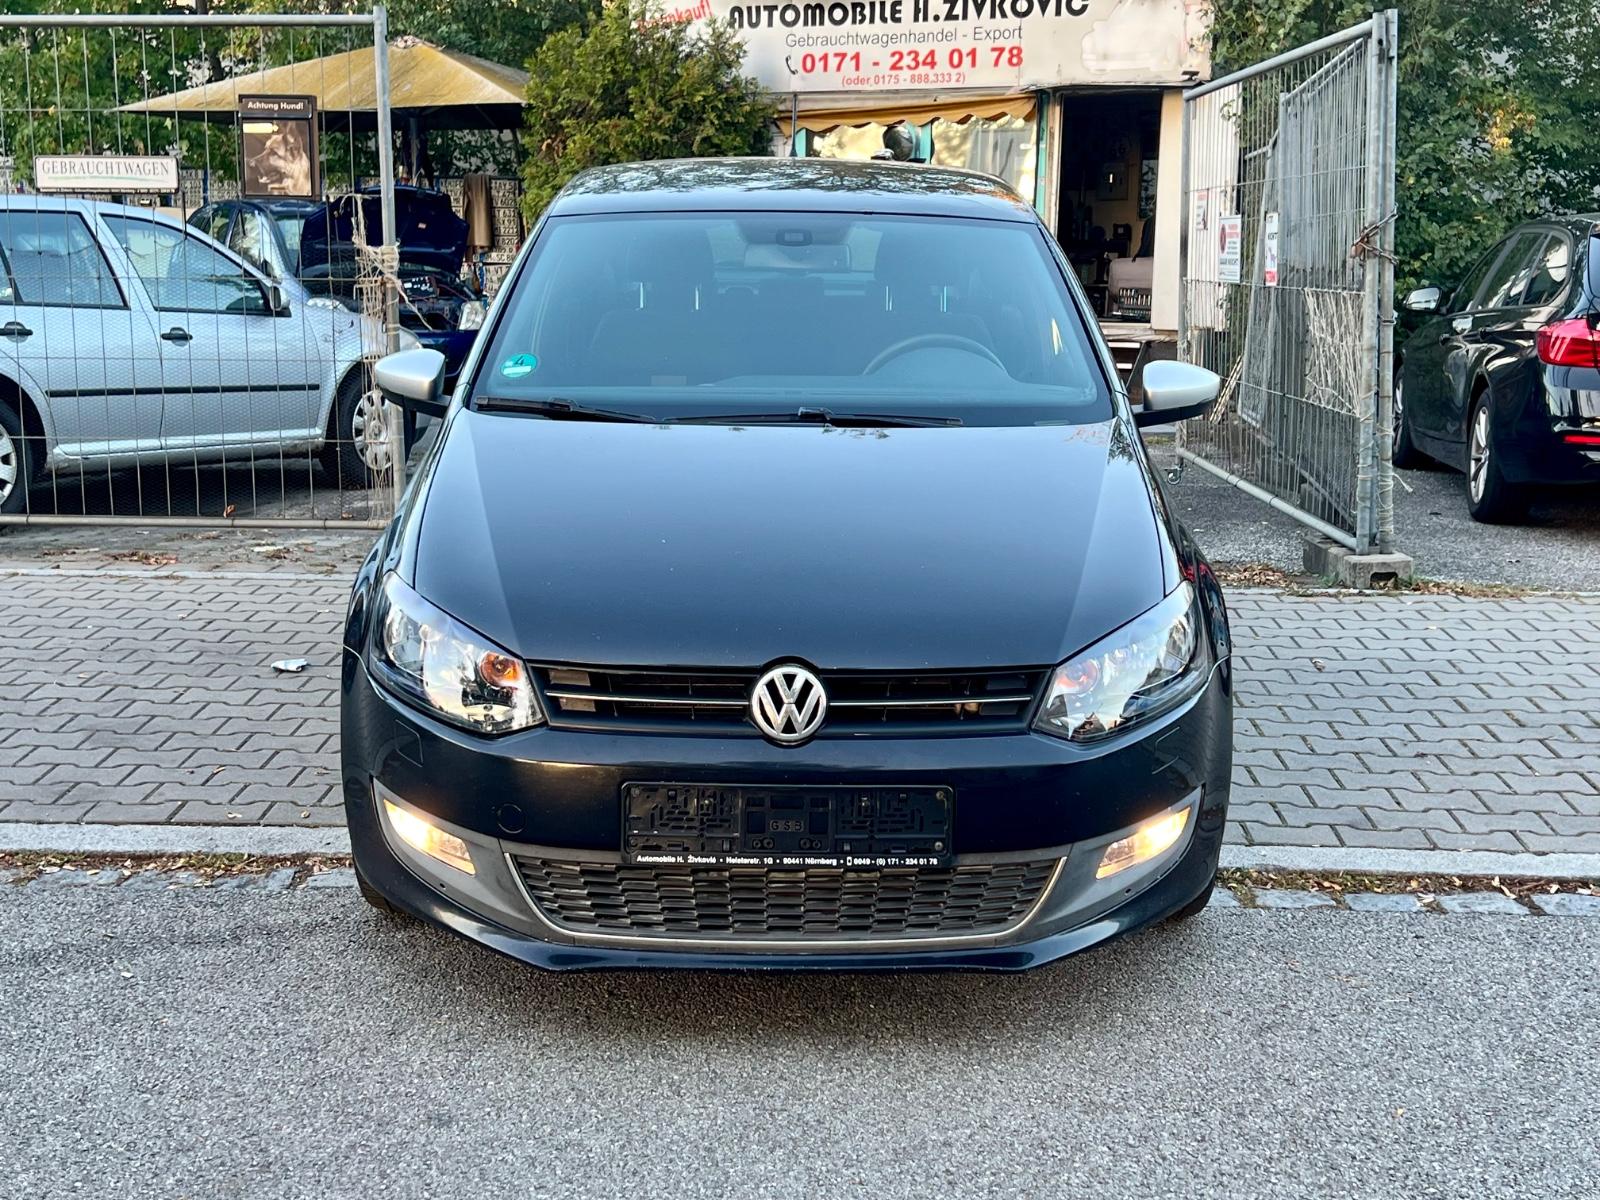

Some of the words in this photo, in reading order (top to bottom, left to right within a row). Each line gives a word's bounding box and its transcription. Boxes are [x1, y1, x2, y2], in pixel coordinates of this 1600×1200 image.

[729, 2, 903, 29] AUTOMOBILE
[785, 28, 957, 48] Gebrauchtwagenhandel
[973, 25, 1023, 43] Export
[801, 52, 861, 73] 0171
[889, 50, 937, 71] 234
[948, 48, 978, 69] 01
[990, 46, 1024, 67] 78
[874, 74, 900, 85] 0175
[955, 72, 966, 83] 2)
[247, 101, 279, 110] Achtung
[280, 102, 304, 110] Hund!
[42, 160, 169, 176] GEBRAUCHTWAGEN
[513, 355, 524, 366] 4
[754, 668, 825, 739] VW
[636, 855, 676, 863] Automobile
[677, 855, 685, 863] H.
[804, 857, 837, 866] Nürnberg
[876, 858, 886, 867] (0)
[887, 858, 900, 866] 171
[905, 858, 918, 866] 234
[919, 858, 928, 866] 01
[929, 858, 938, 866] 78
